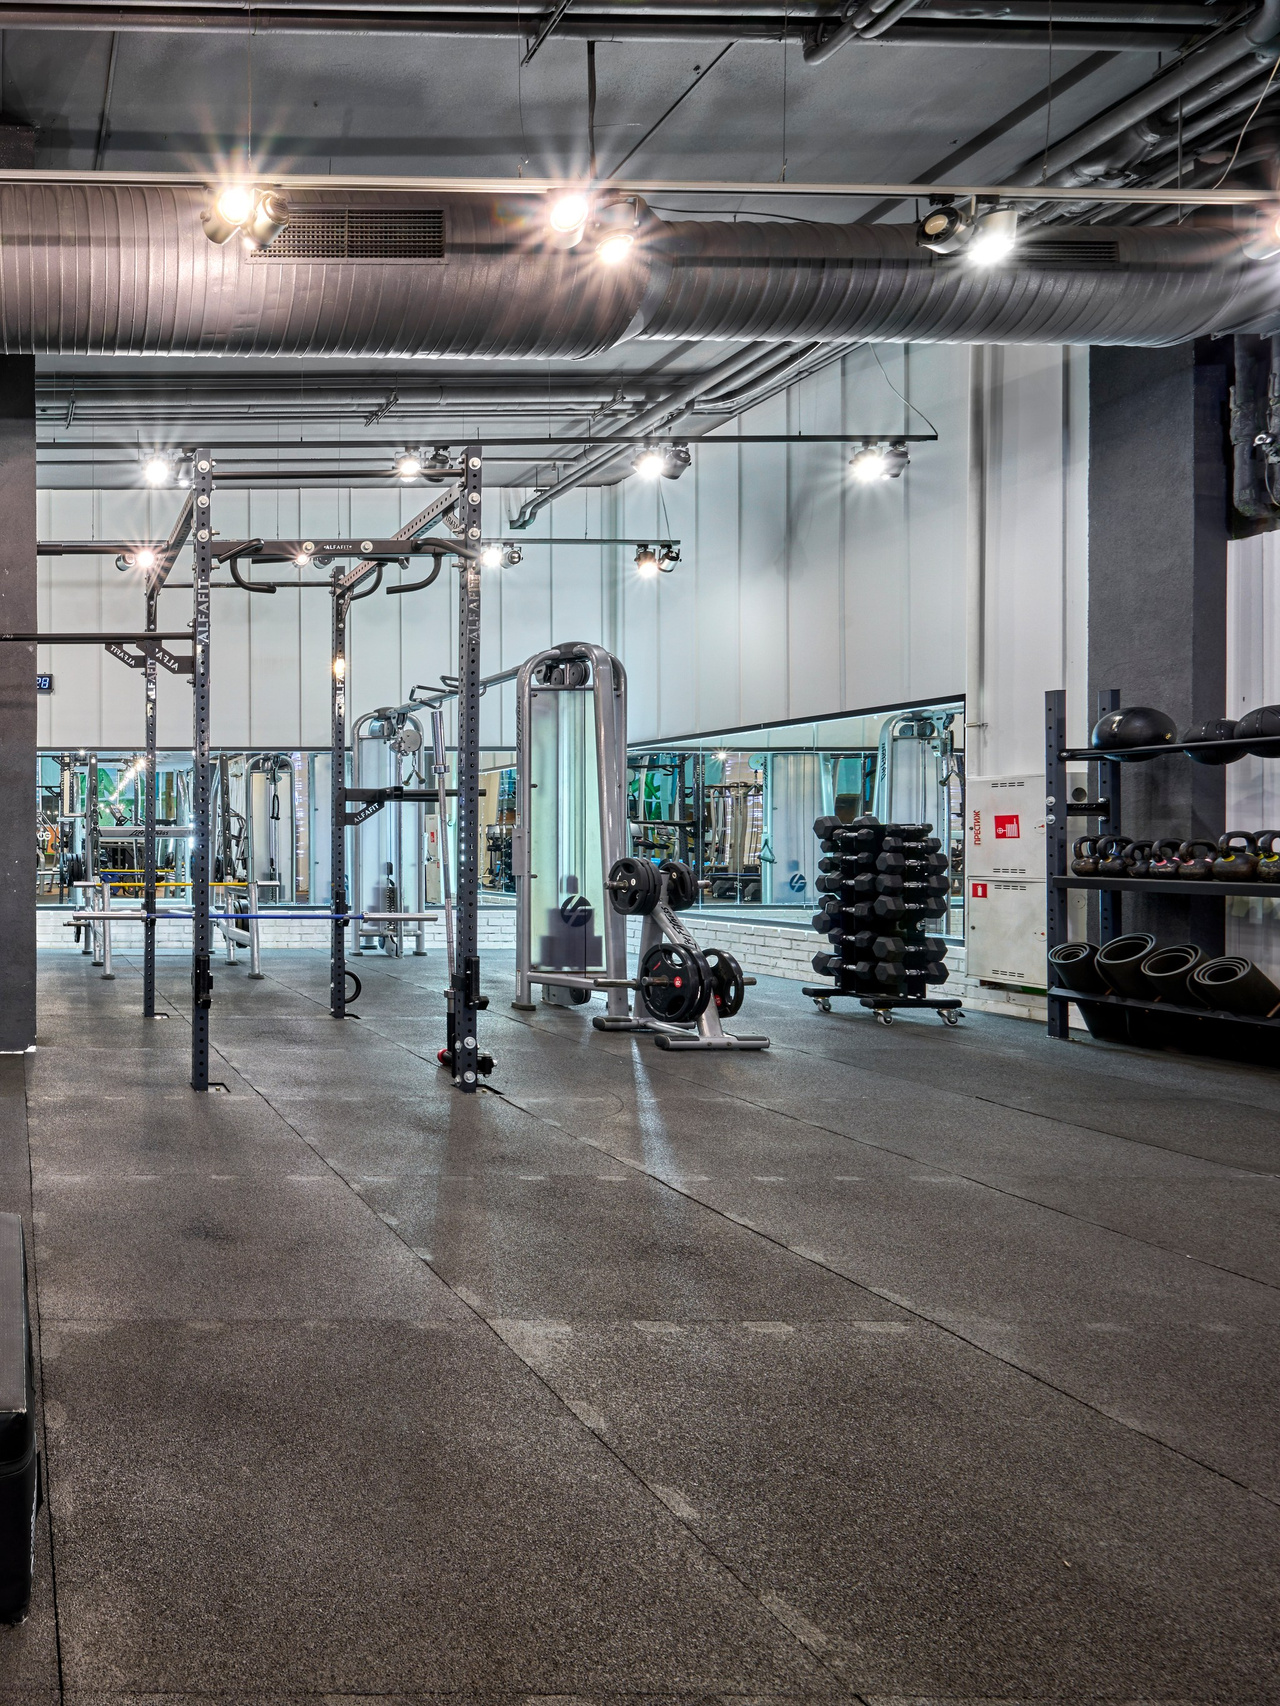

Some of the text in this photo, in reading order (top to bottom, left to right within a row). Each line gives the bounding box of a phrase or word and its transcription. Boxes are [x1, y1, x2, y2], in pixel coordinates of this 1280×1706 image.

[197, 578, 210, 644] ALFAFIT
[354, 803, 379, 823] ALFAFIT
[973, 810, 981, 846] ПРЕСТИЖ
